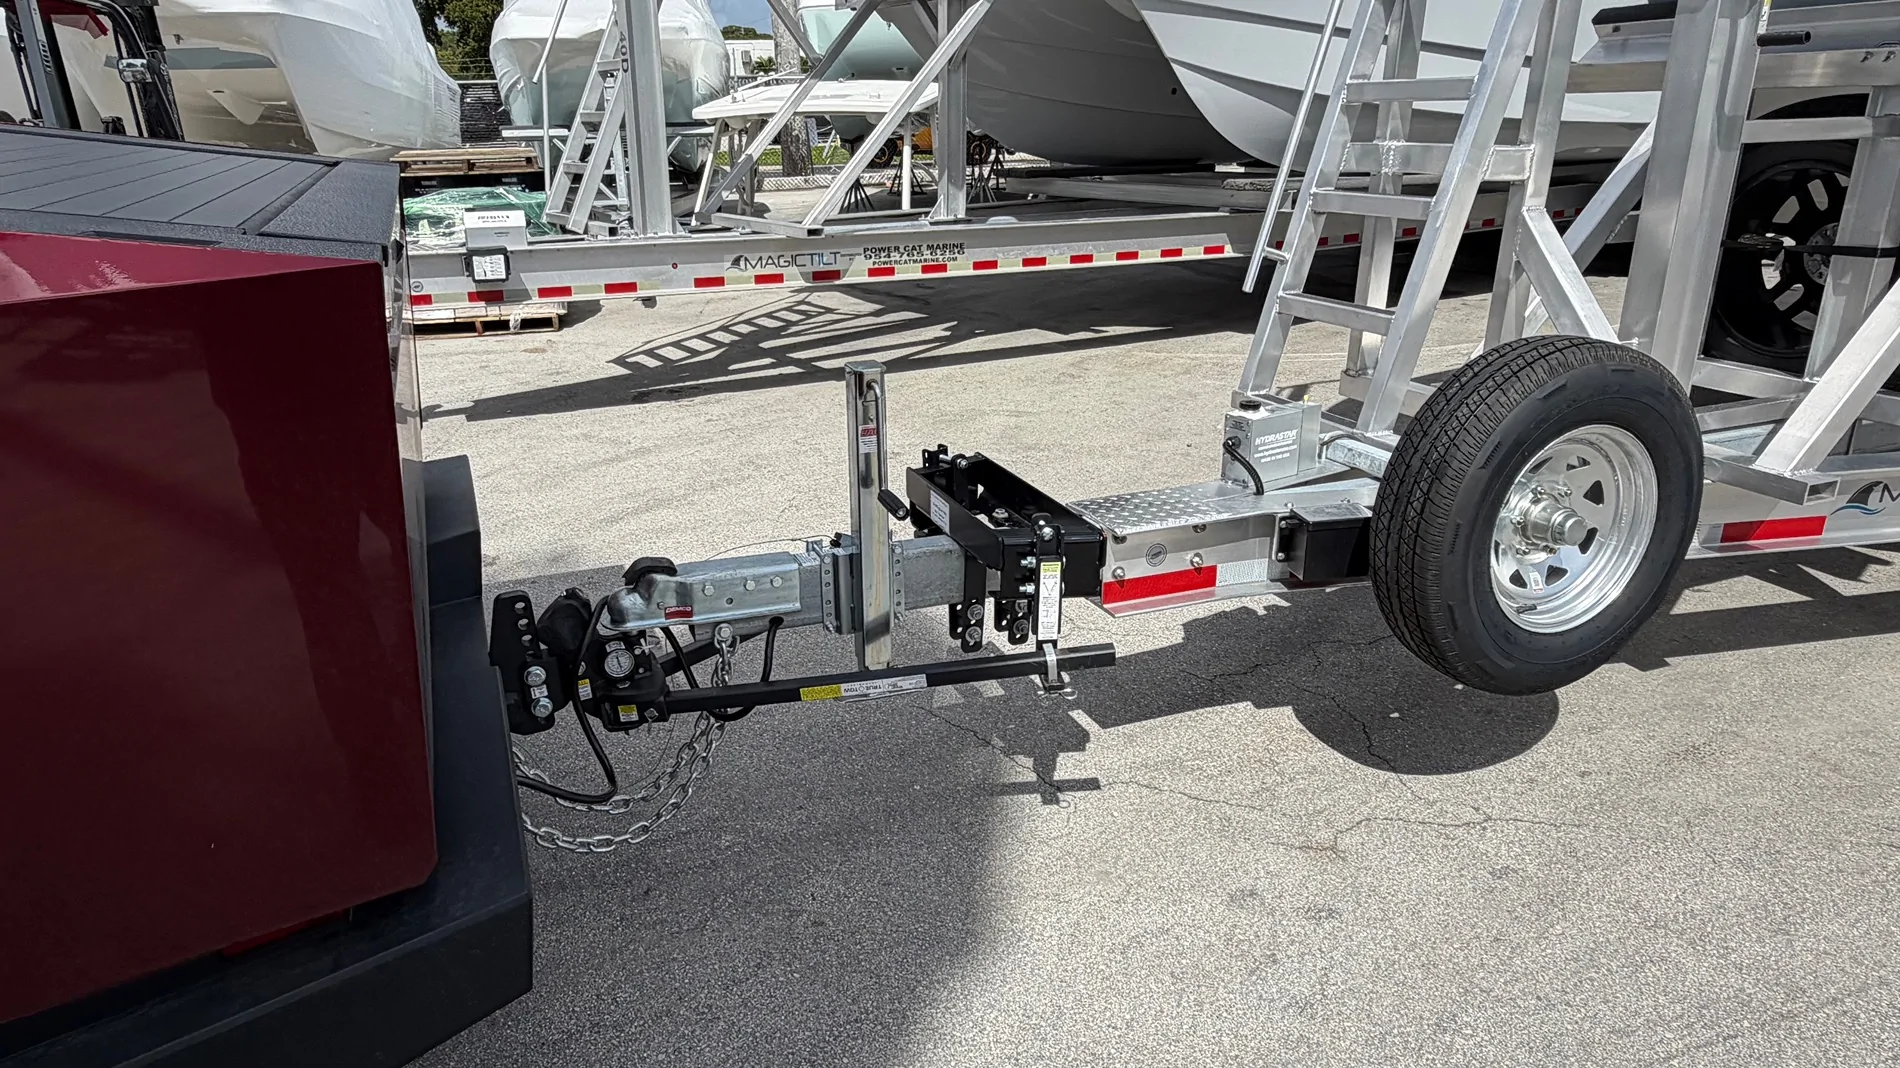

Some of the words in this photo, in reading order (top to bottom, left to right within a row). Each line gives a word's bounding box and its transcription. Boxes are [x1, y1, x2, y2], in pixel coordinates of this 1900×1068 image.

[863, 246, 900, 255] POWER
[903, 244, 924, 253] CAT
[926, 242, 966, 252] MARINE
[744, 252, 840, 270] MAGICTILT
[872, 256, 958, 267] POWERCATMARINE.COM
[1255, 428, 1299, 446] HYDRASTAR
